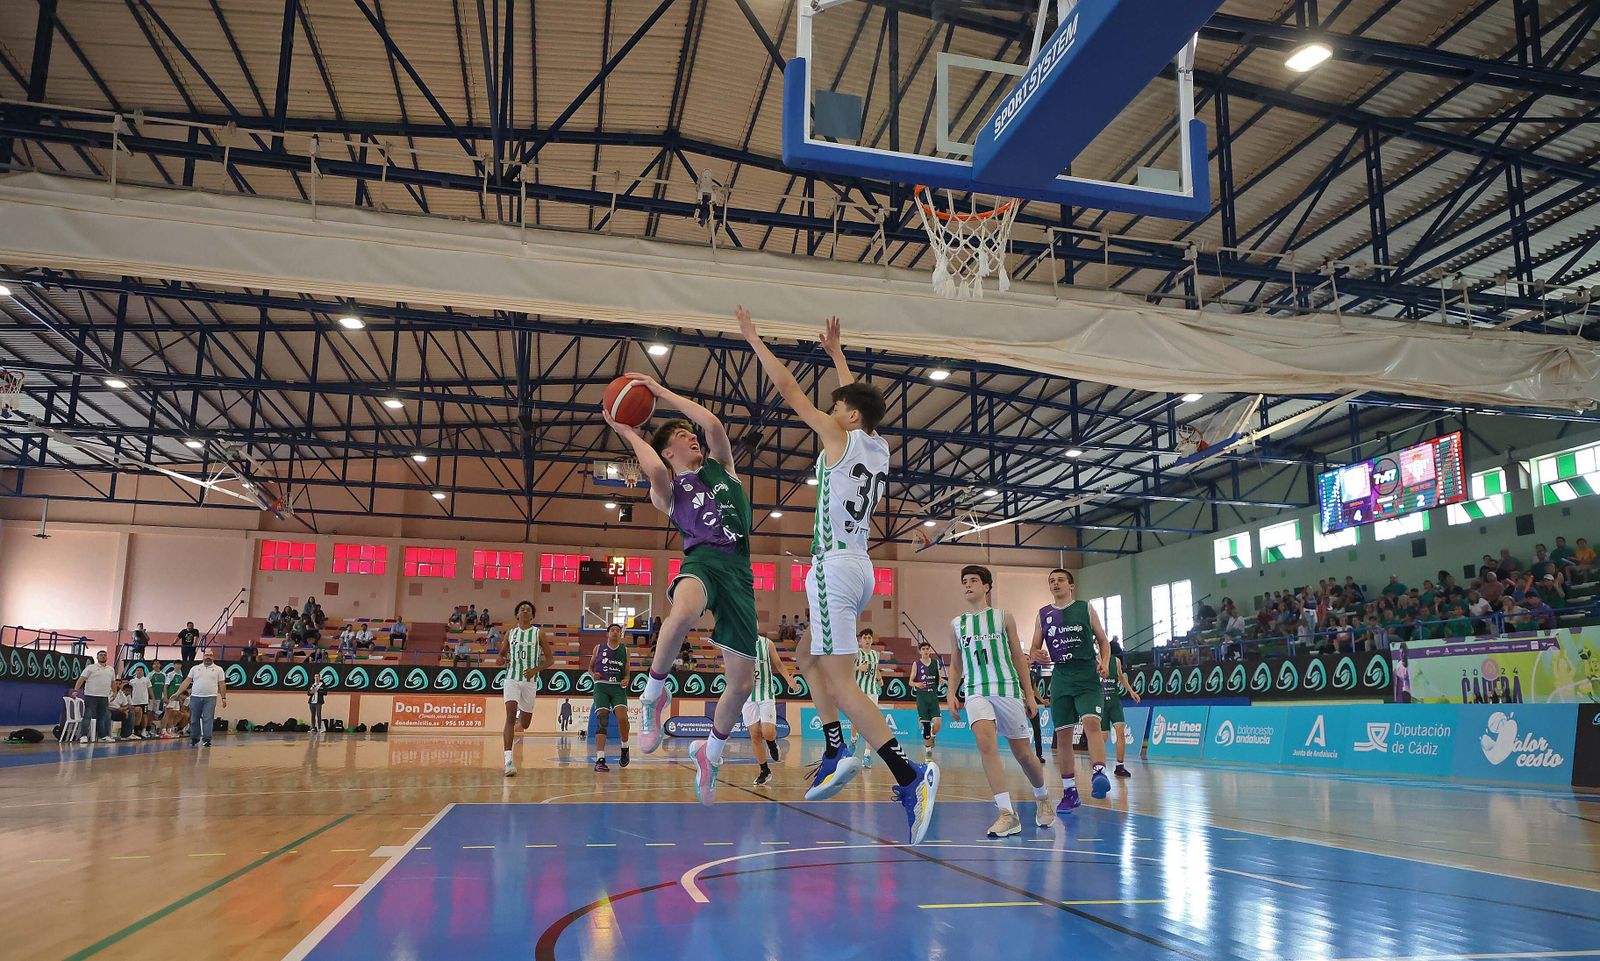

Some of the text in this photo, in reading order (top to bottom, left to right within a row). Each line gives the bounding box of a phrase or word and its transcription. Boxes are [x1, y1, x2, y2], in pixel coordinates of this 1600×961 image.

[1353, 509, 1363, 522] 4
[608, 563, 625, 575] 22
[517, 650, 527, 660] 10
[973, 648, 989, 666] 11
[395, 702, 483, 714] Don Domicilio
[572, 705, 580, 713] La
[1167, 721, 1178, 731] La
[1237, 725, 1274, 736] baloncesto
[1393, 722, 1451, 738] Diputación
[1313, 750, 1338, 758] Andalucía
[1391, 740, 1439, 756] de Cádiz
[1515, 749, 1564, 768] cesto
